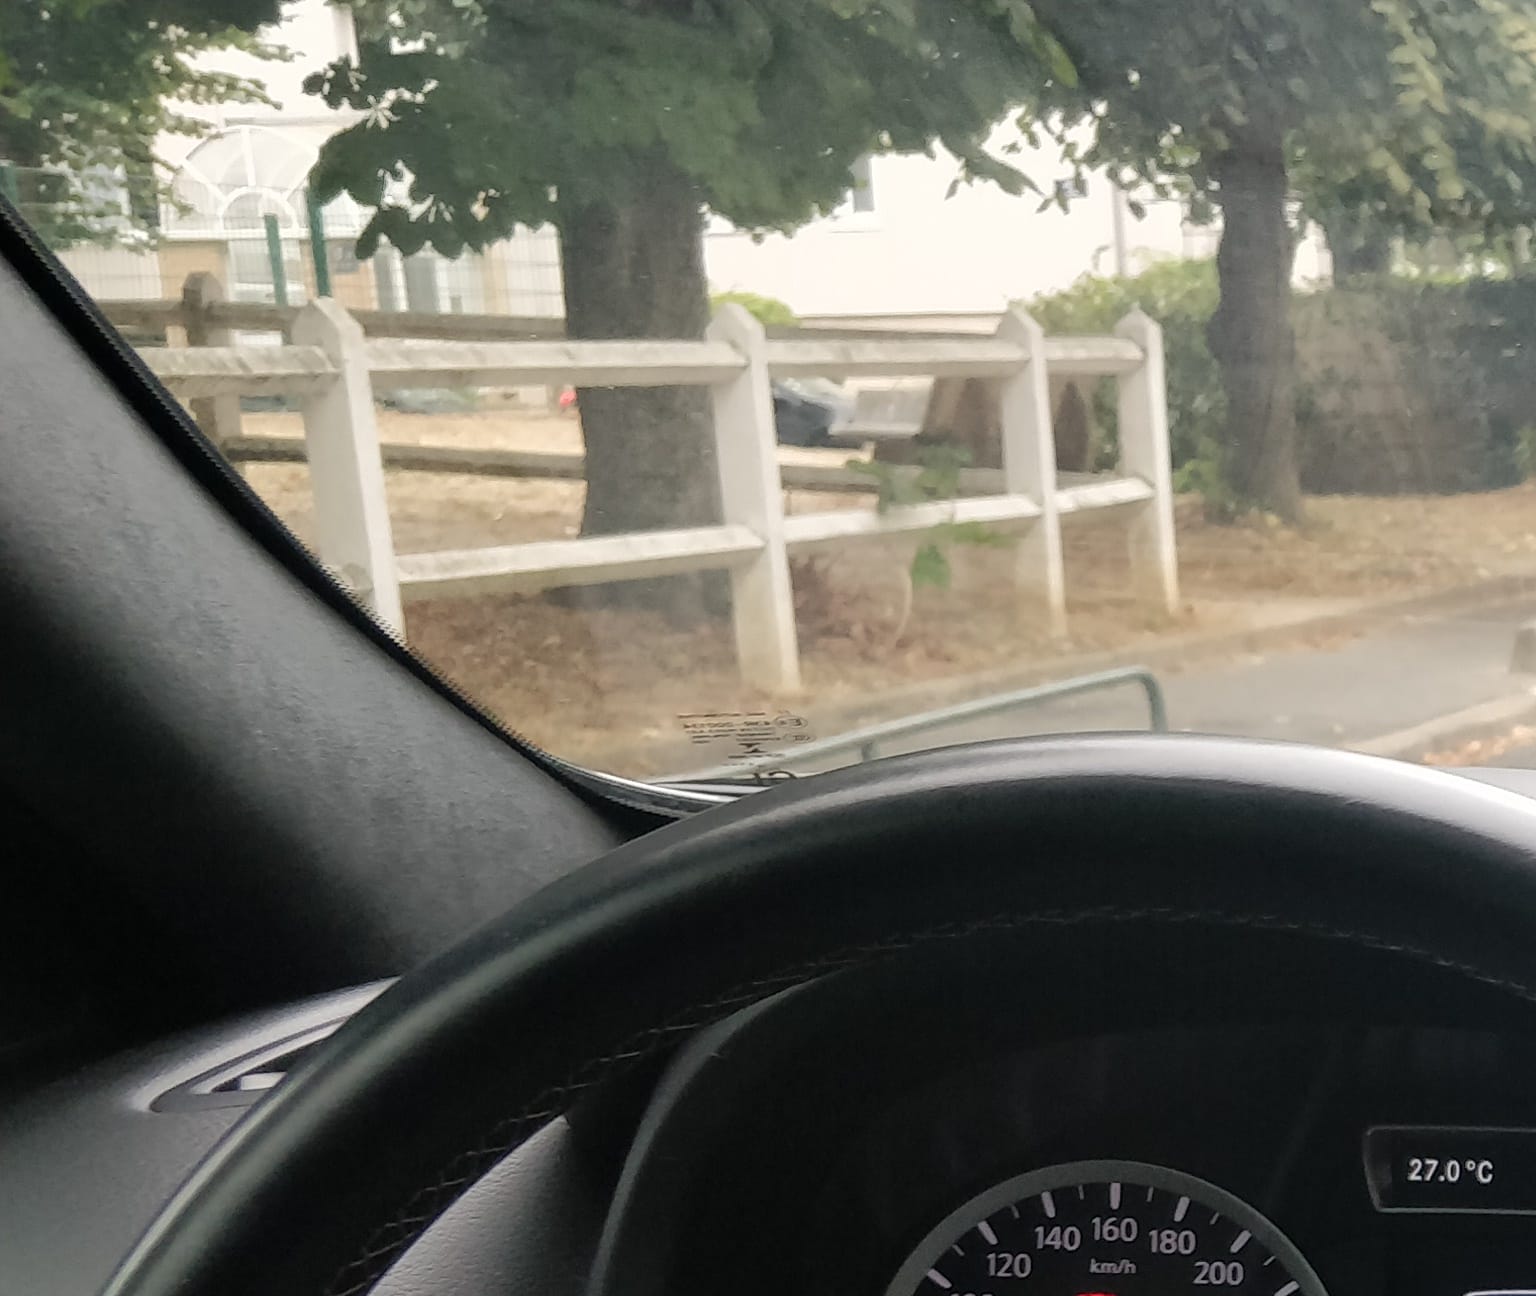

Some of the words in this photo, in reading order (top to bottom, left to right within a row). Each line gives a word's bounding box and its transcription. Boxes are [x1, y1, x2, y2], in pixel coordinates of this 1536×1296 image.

[1035, 1226, 1081, 1252] 140
[1091, 1216, 1138, 1243] 160
[1149, 1229, 1197, 1256] 180
[987, 1253, 1032, 1278] 120
[1089, 1258, 1137, 1275] km/h
[1193, 1261, 1244, 1287] 200
